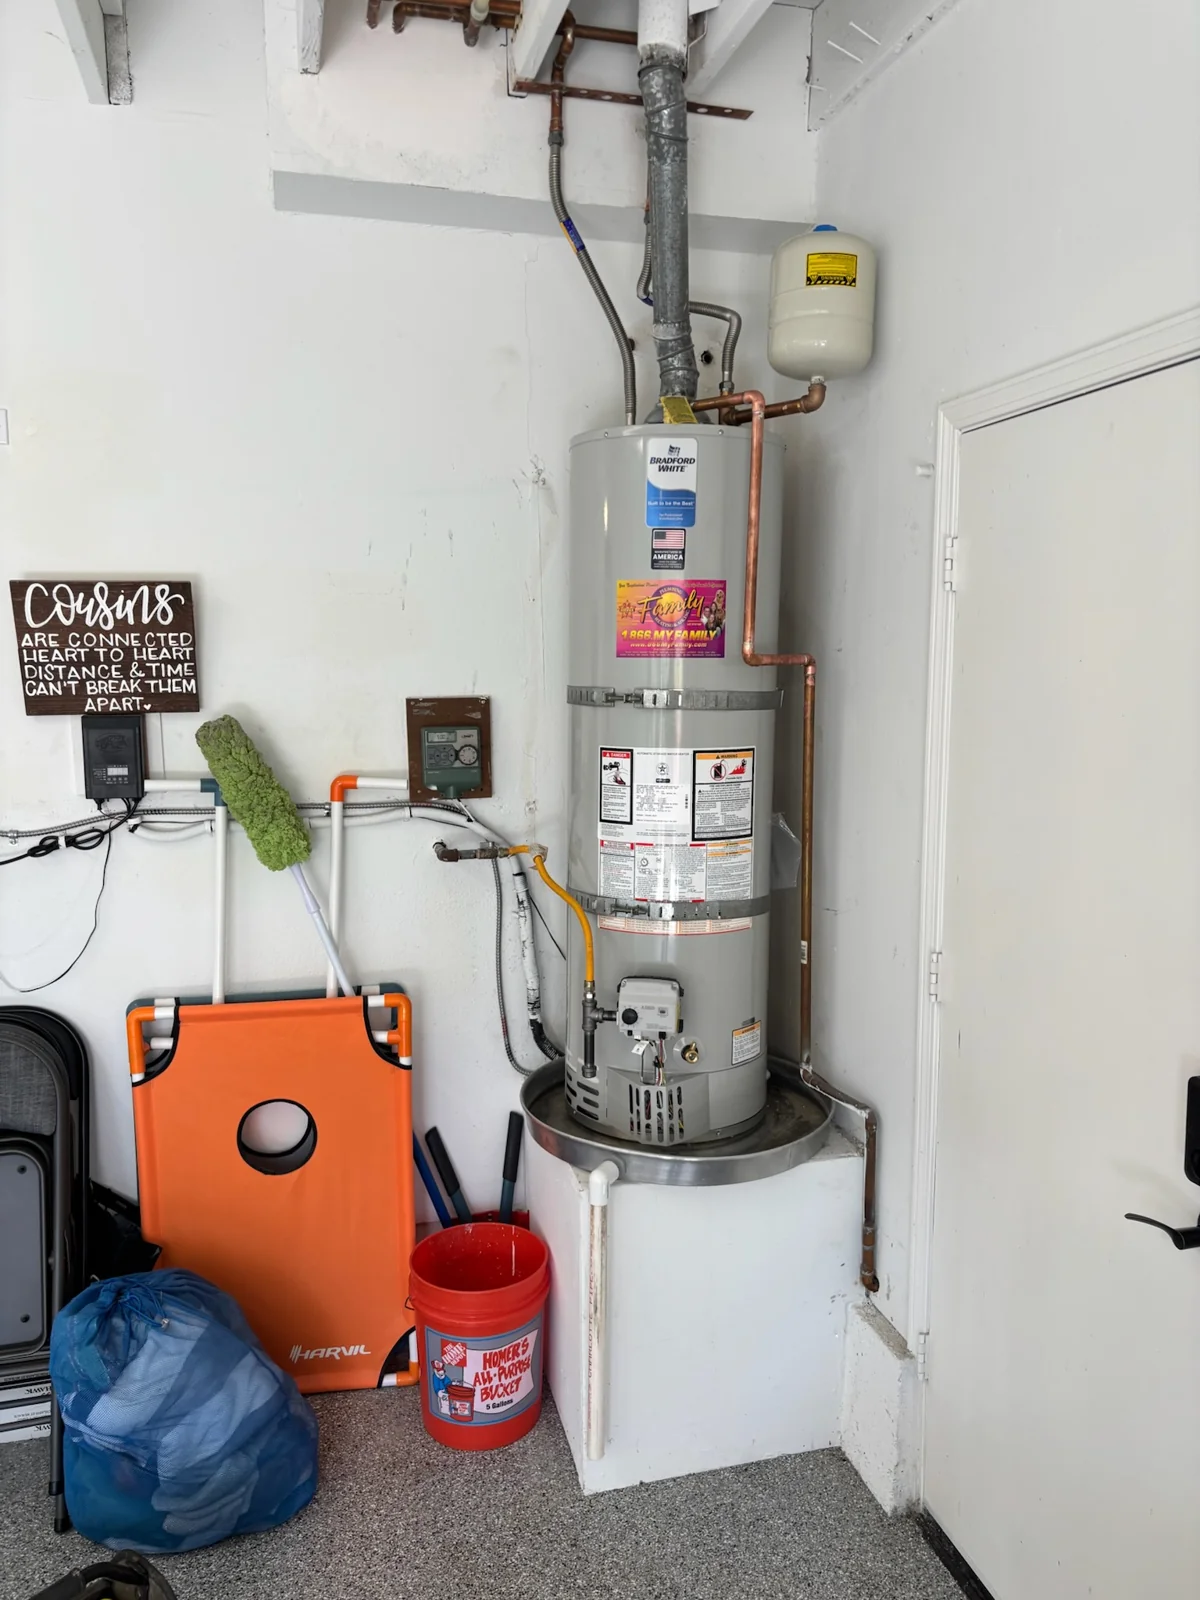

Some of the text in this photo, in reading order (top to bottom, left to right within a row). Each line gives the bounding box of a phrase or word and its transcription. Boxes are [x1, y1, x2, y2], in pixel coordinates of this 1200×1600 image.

[24, 582, 184, 630] Cousins
[637, 589, 704, 624] Family
[21, 632, 192, 648] ARE CONNECTED
[22, 647, 194, 663] HEART TO HEART
[24, 662, 194, 680] DISTANCE & TIME
[25, 679, 196, 696] CAN'T BREAK THEM
[84, 696, 144, 712] APART
[290, 1345, 371, 1364] HARVIL
[442, 1342, 466, 1364] HOME
[483, 1337, 529, 1370] HOMER'S
[480, 1376, 522, 1403] BUCKET
[492, 1398, 514, 1409] Gallons
